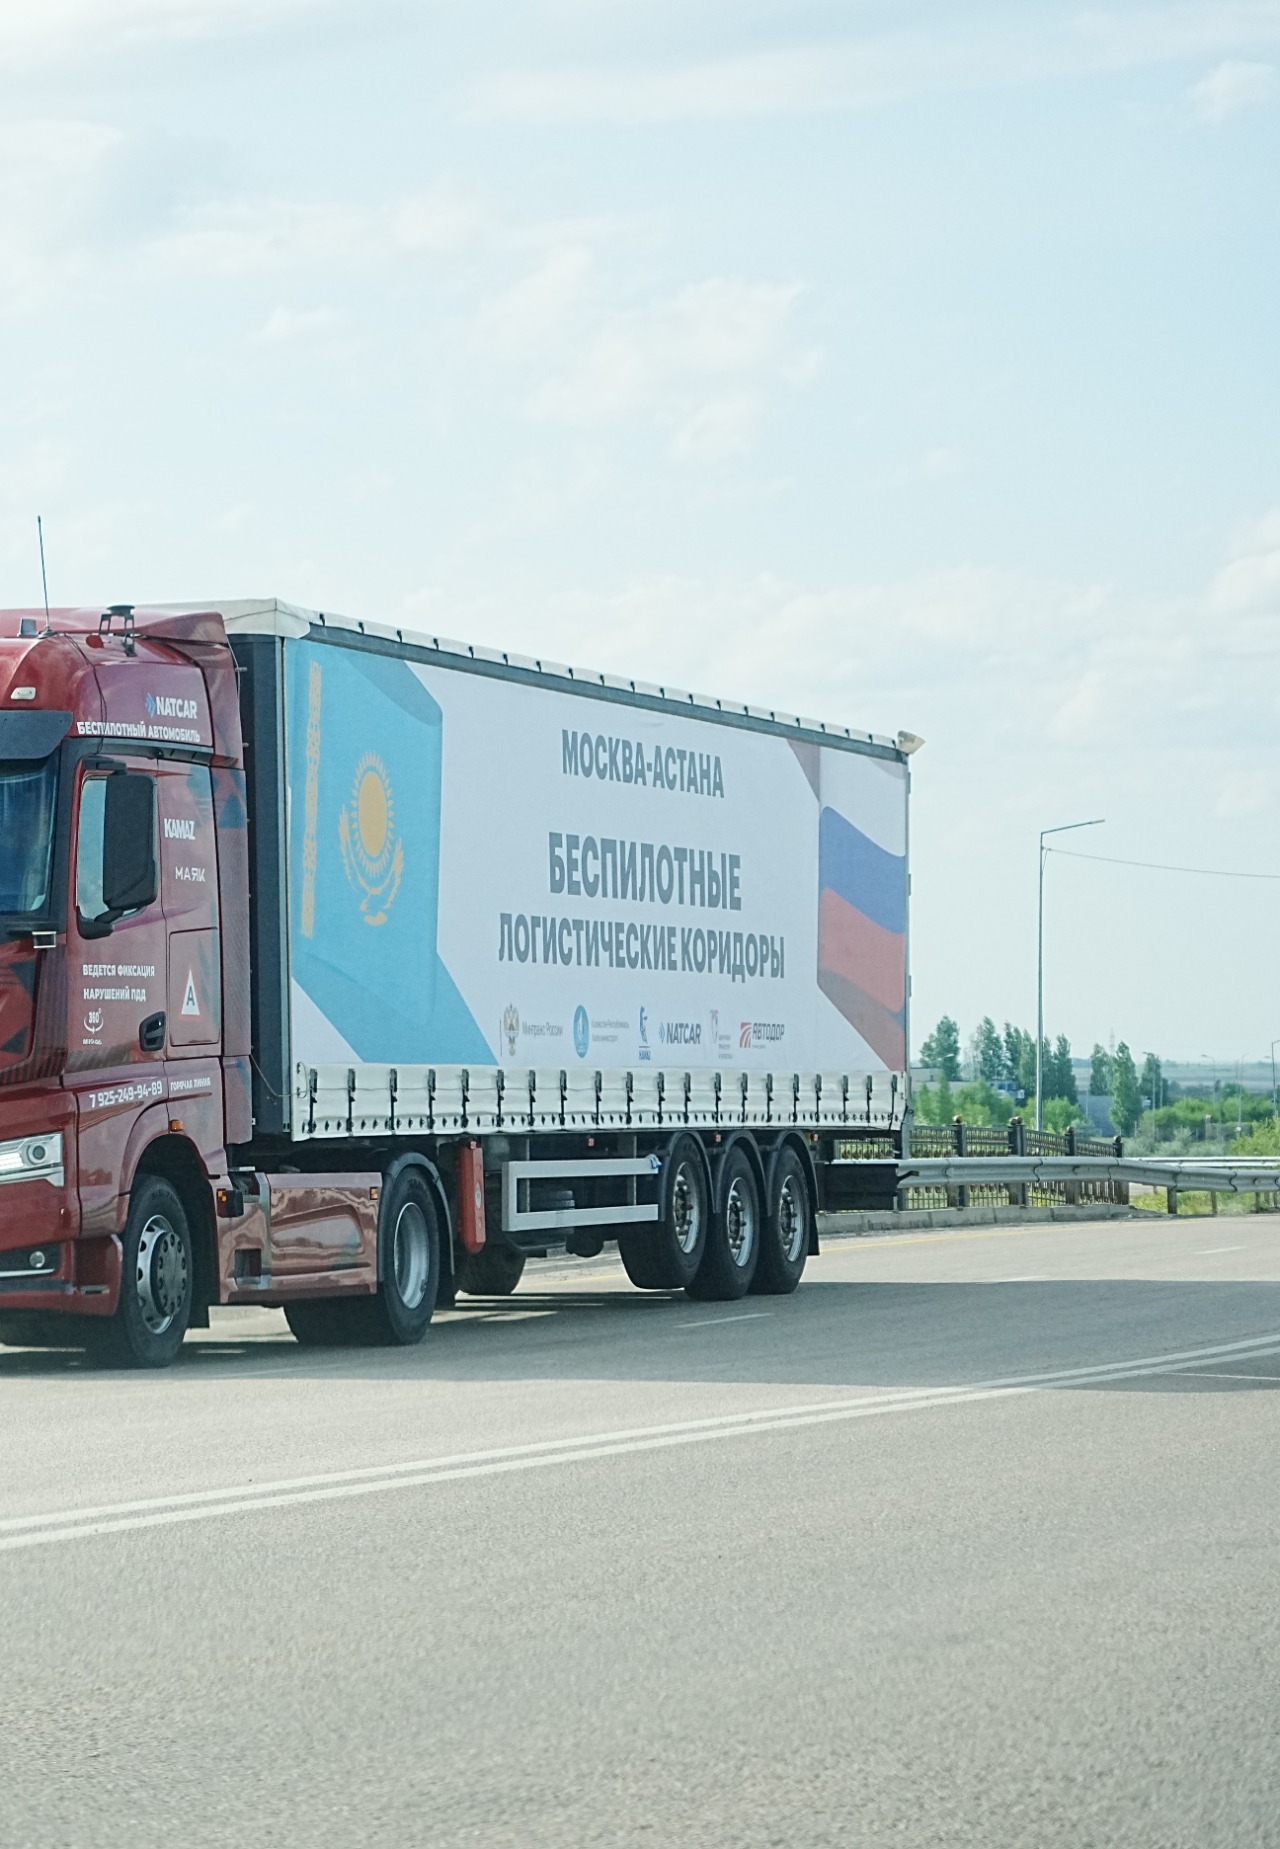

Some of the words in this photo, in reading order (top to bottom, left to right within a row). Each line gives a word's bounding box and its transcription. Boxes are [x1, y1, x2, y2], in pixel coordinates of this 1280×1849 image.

[156, 696, 198, 719] NATCAR
[76, 720, 147, 737] БЕСПИЛОТНЫЙ
[148, 725, 200, 742] АВТОМОБИЛЬ
[561, 728, 725, 799] МОСКВА-АСТАНА
[164, 818, 195, 840] KAMAZ
[175, 866, 206, 882] МАЯК
[548, 831, 742, 911] БЕСПИЛОТНЫЕ
[498, 912, 678, 972] ЛОГИСТИЧЕСКИЕ
[680, 927, 785, 984] КОРИДОРЫ
[83, 964, 116, 978] ВЕДЕТСЯ
[117, 965, 155, 978] ФИКСАЦИЯ
[83, 986, 130, 1000] НАРУШЕНИЙ
[131, 988, 146, 1002] ПДД
[666, 1022, 702, 1044] NATCAR
[752, 1022, 785, 1042] АВТОДОР
